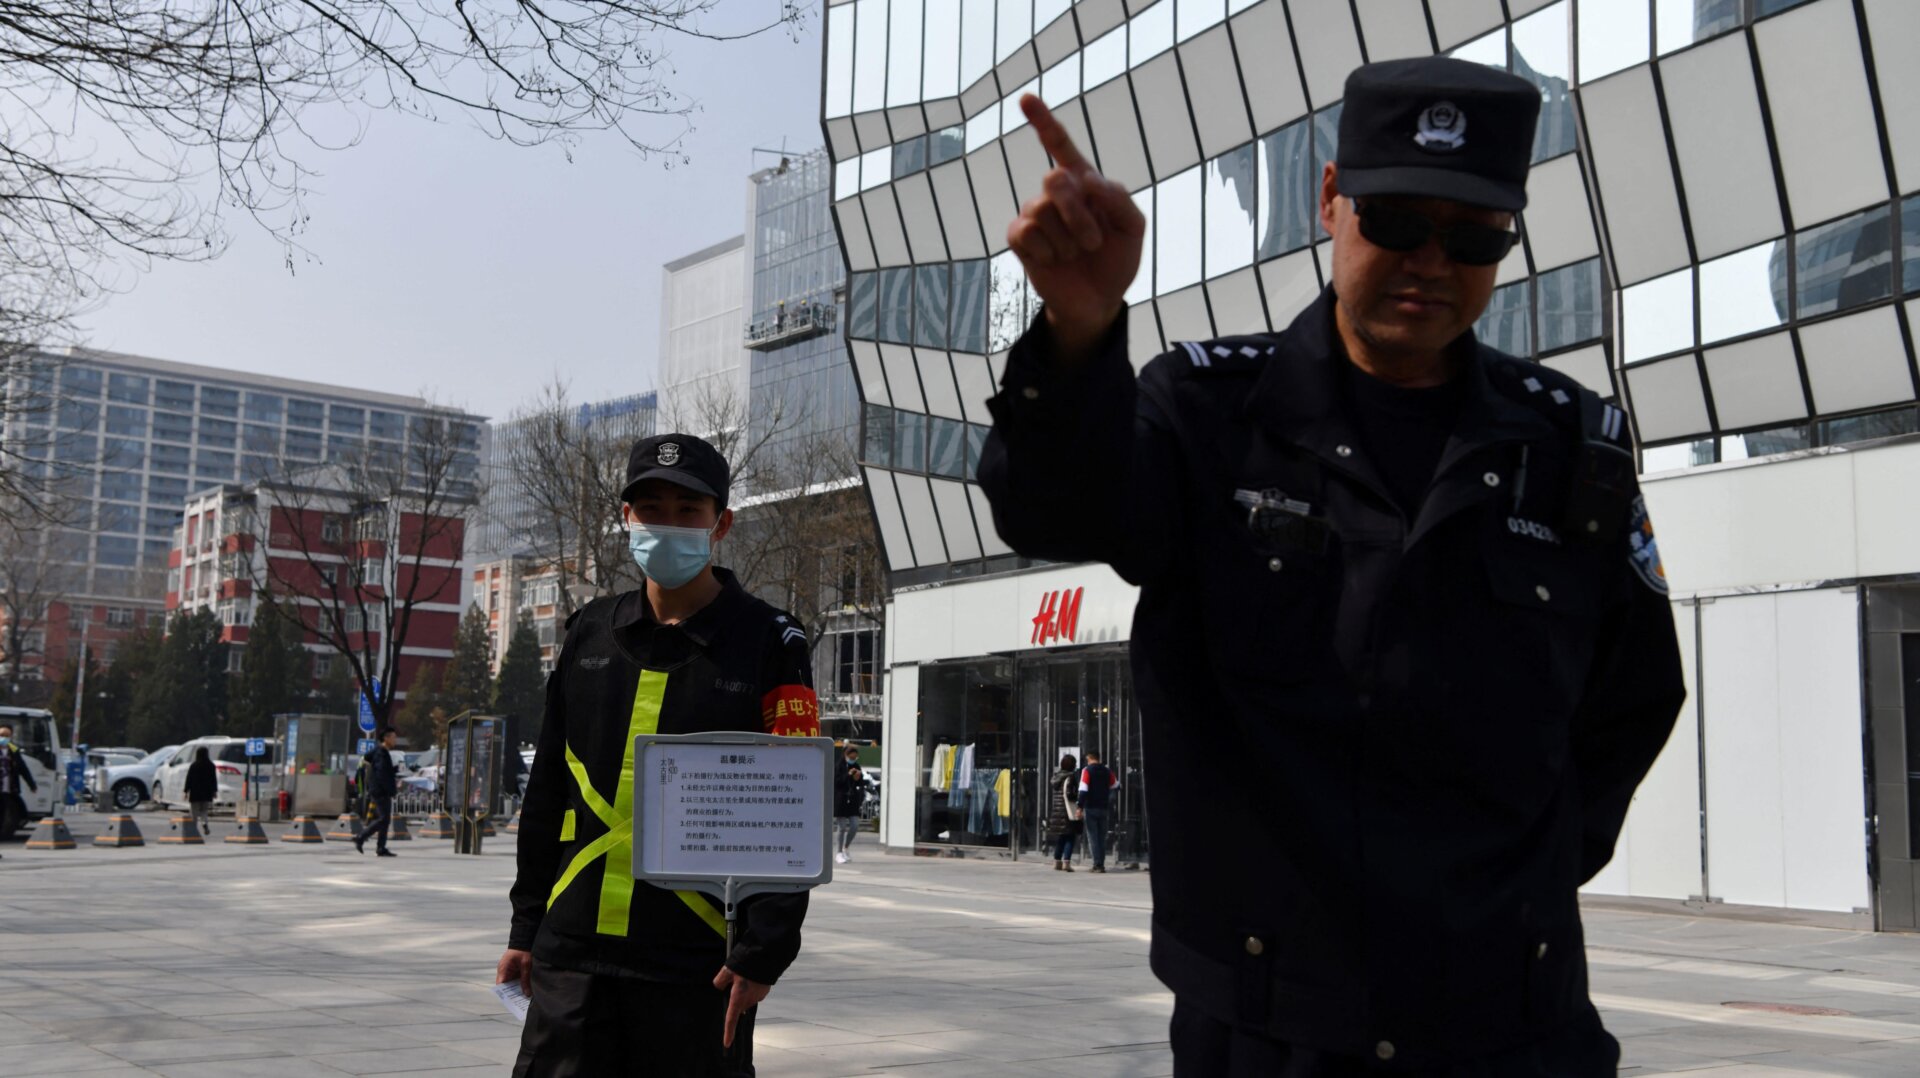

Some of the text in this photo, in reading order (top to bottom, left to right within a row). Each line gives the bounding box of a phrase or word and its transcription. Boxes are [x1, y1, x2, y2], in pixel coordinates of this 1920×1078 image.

[1031, 586, 1084, 646] H&M
[720, 754, 756, 764] 温馨提示
